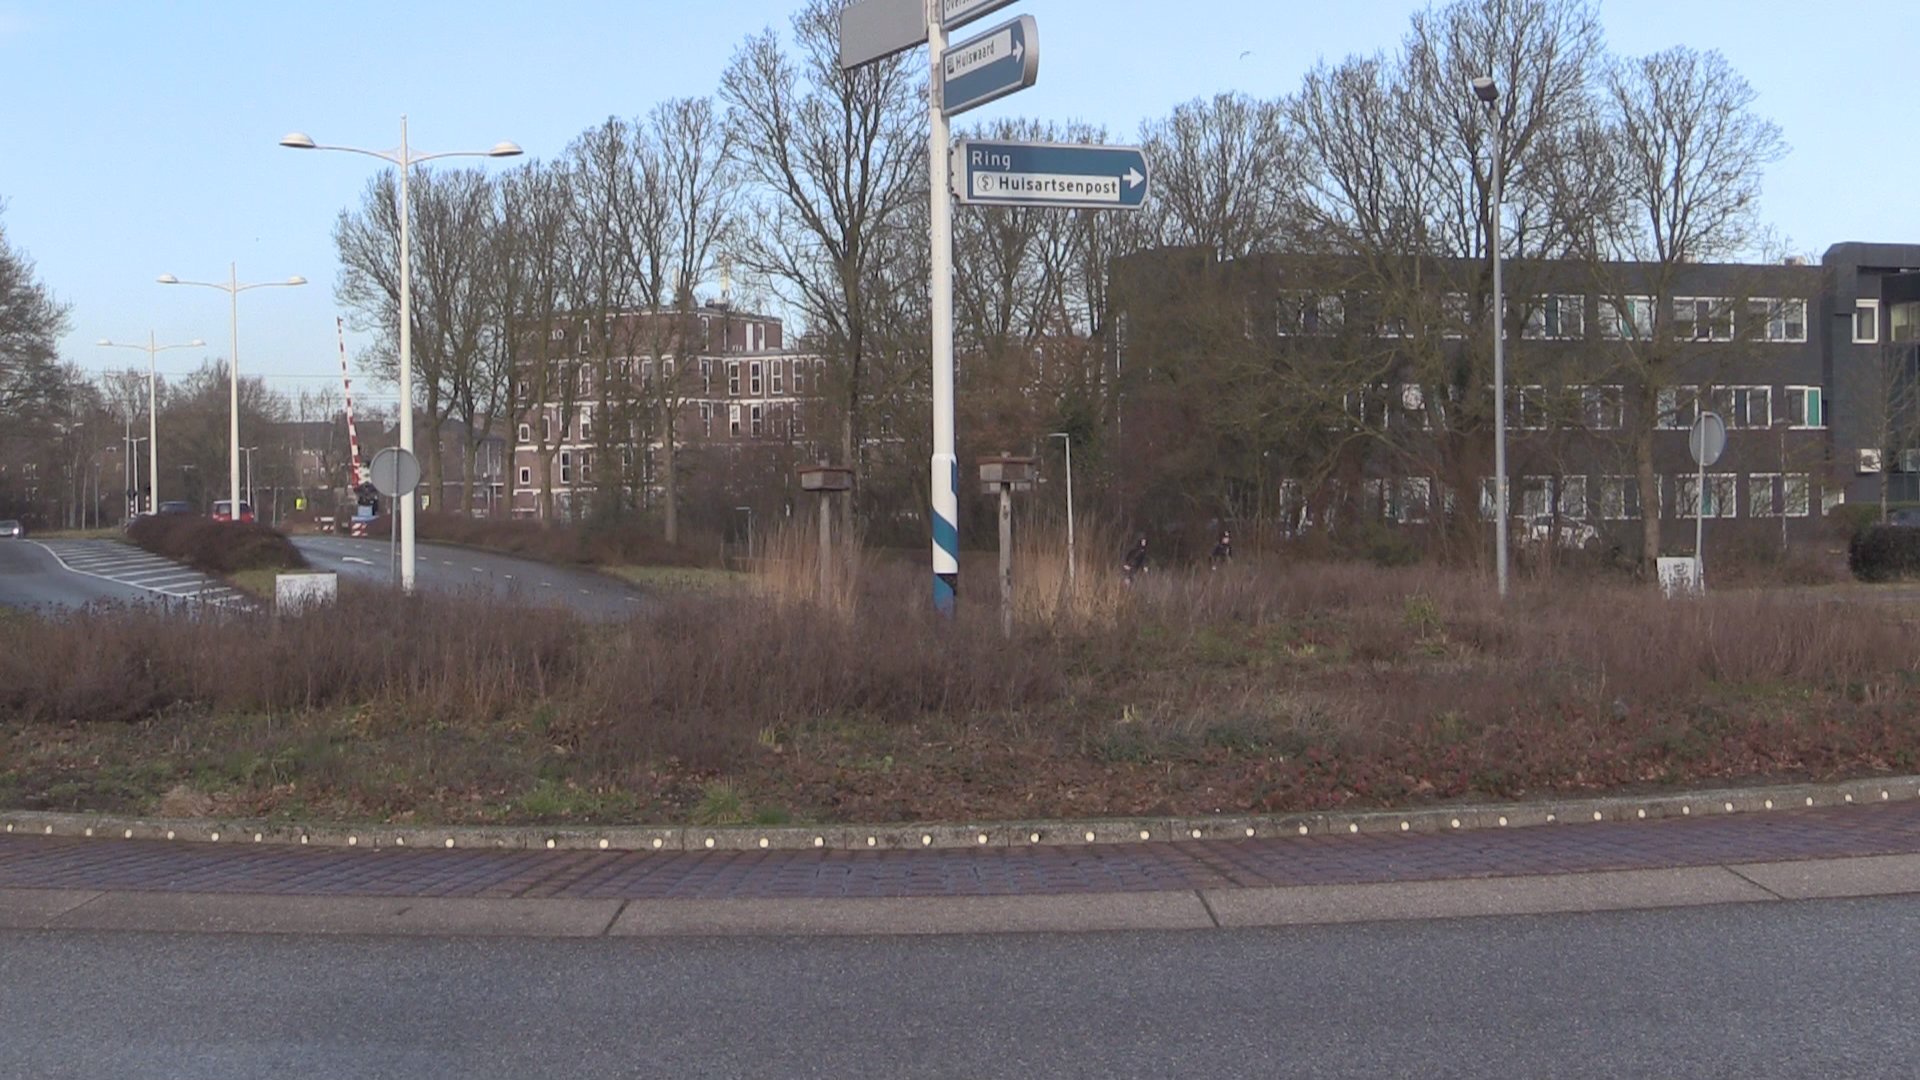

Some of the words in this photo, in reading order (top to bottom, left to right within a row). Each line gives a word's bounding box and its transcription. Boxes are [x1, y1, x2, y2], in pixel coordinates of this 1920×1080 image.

[955, 40, 995, 70] Huiswaard
[972, 151, 1011, 171] Ring
[999, 176, 1118, 196] Huisartsenpost
